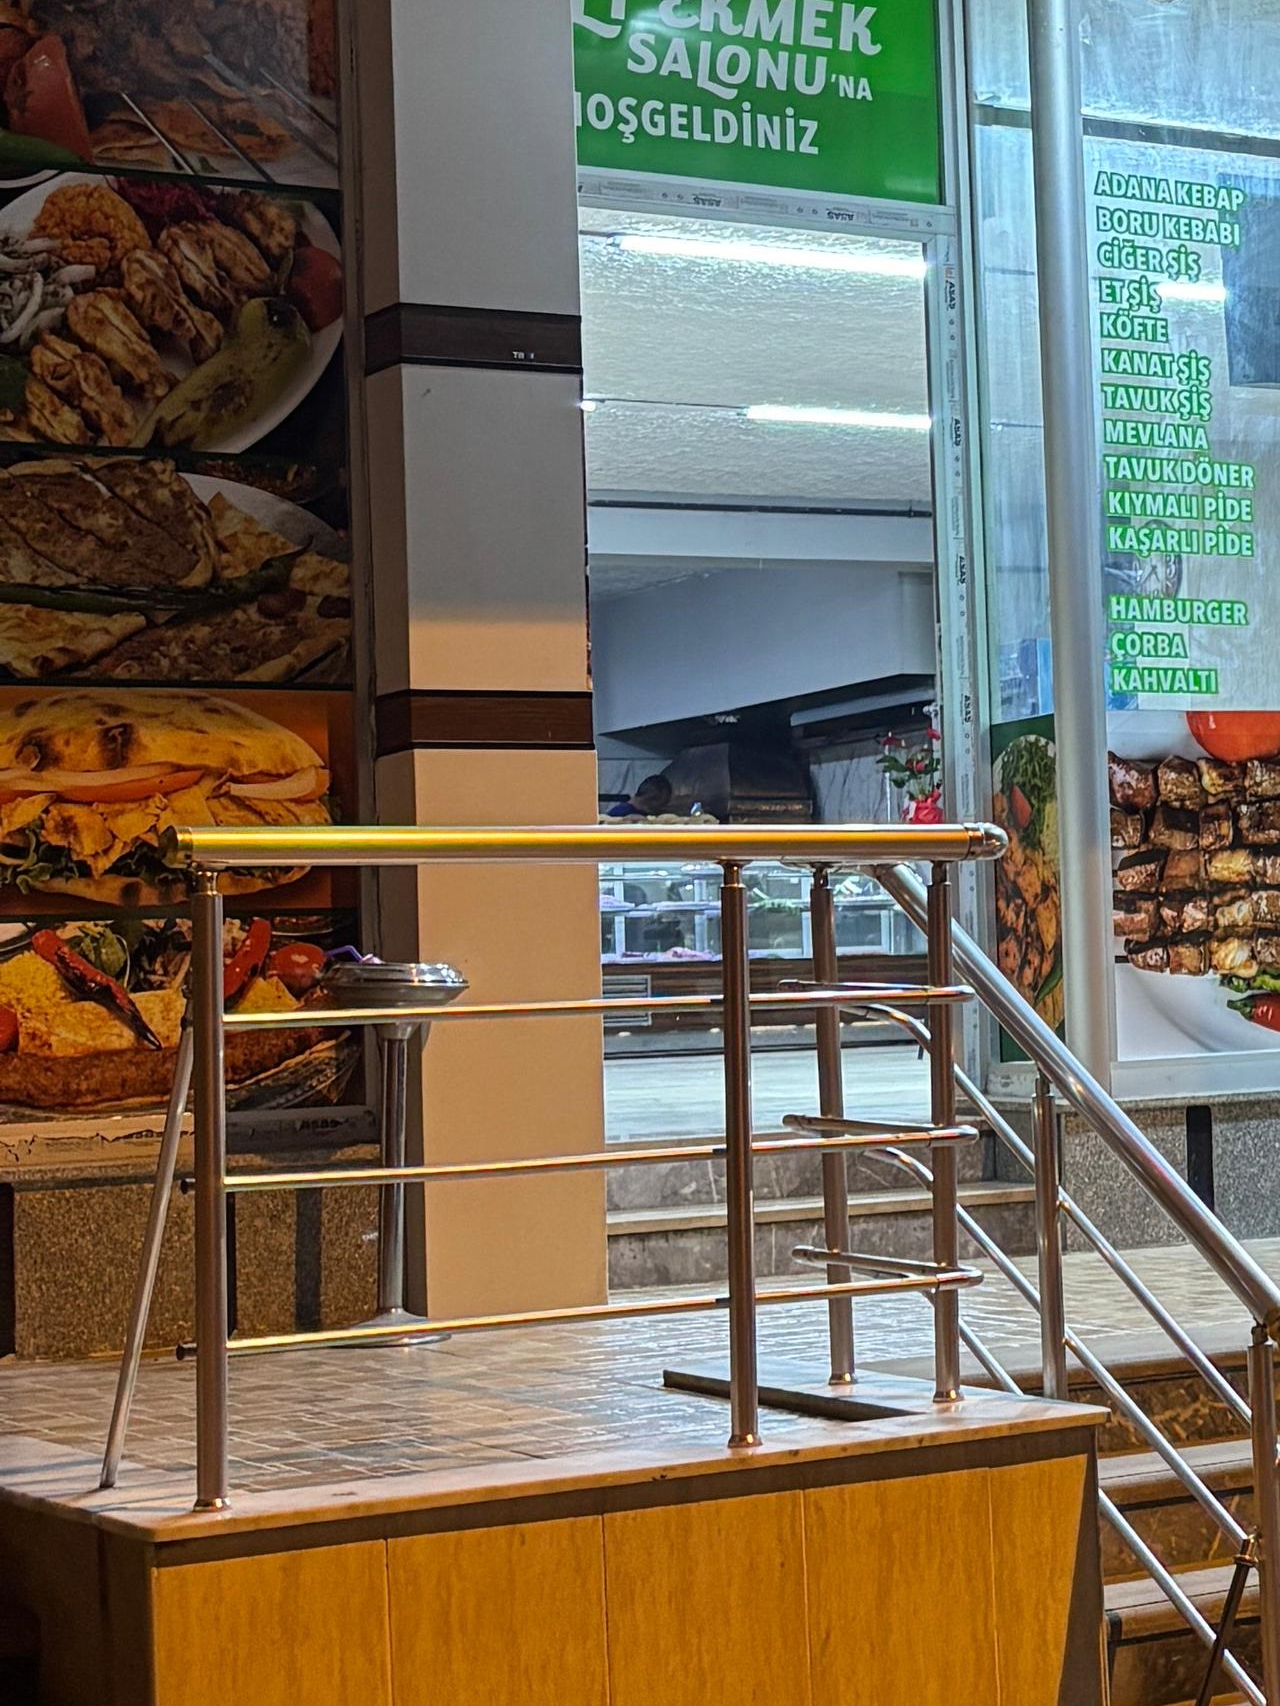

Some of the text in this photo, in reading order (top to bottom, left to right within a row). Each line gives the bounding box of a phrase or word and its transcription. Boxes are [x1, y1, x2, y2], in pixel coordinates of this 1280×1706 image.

[1095, 171, 1245, 212] ADANA KEBAP
[1096, 207, 1241, 248] BORU KEBABI
[1097, 237, 1202, 283] CİĞER ŞİŞ
[1099, 276, 1163, 313] ET ŞİŞ
[1100, 308, 1169, 343] KÖFTE
[1101, 348, 1211, 387] KANAT ŞİŞ
[1101, 383, 1212, 421] TAVUK ŞİŞ
[1104, 420, 1209, 451] MEVLANA
[1104, 454, 1255, 488] TAVUK DÖNER
[1107, 491, 1253, 522] KIYMALI PİDE
[1108, 525, 1254, 557] KAŞARLI PİDE
[1110, 596, 1248, 625] HAMBURGER
[1111, 632, 1188, 661] ÇORBA
[1112, 667, 1218, 694] KAHVALTI
